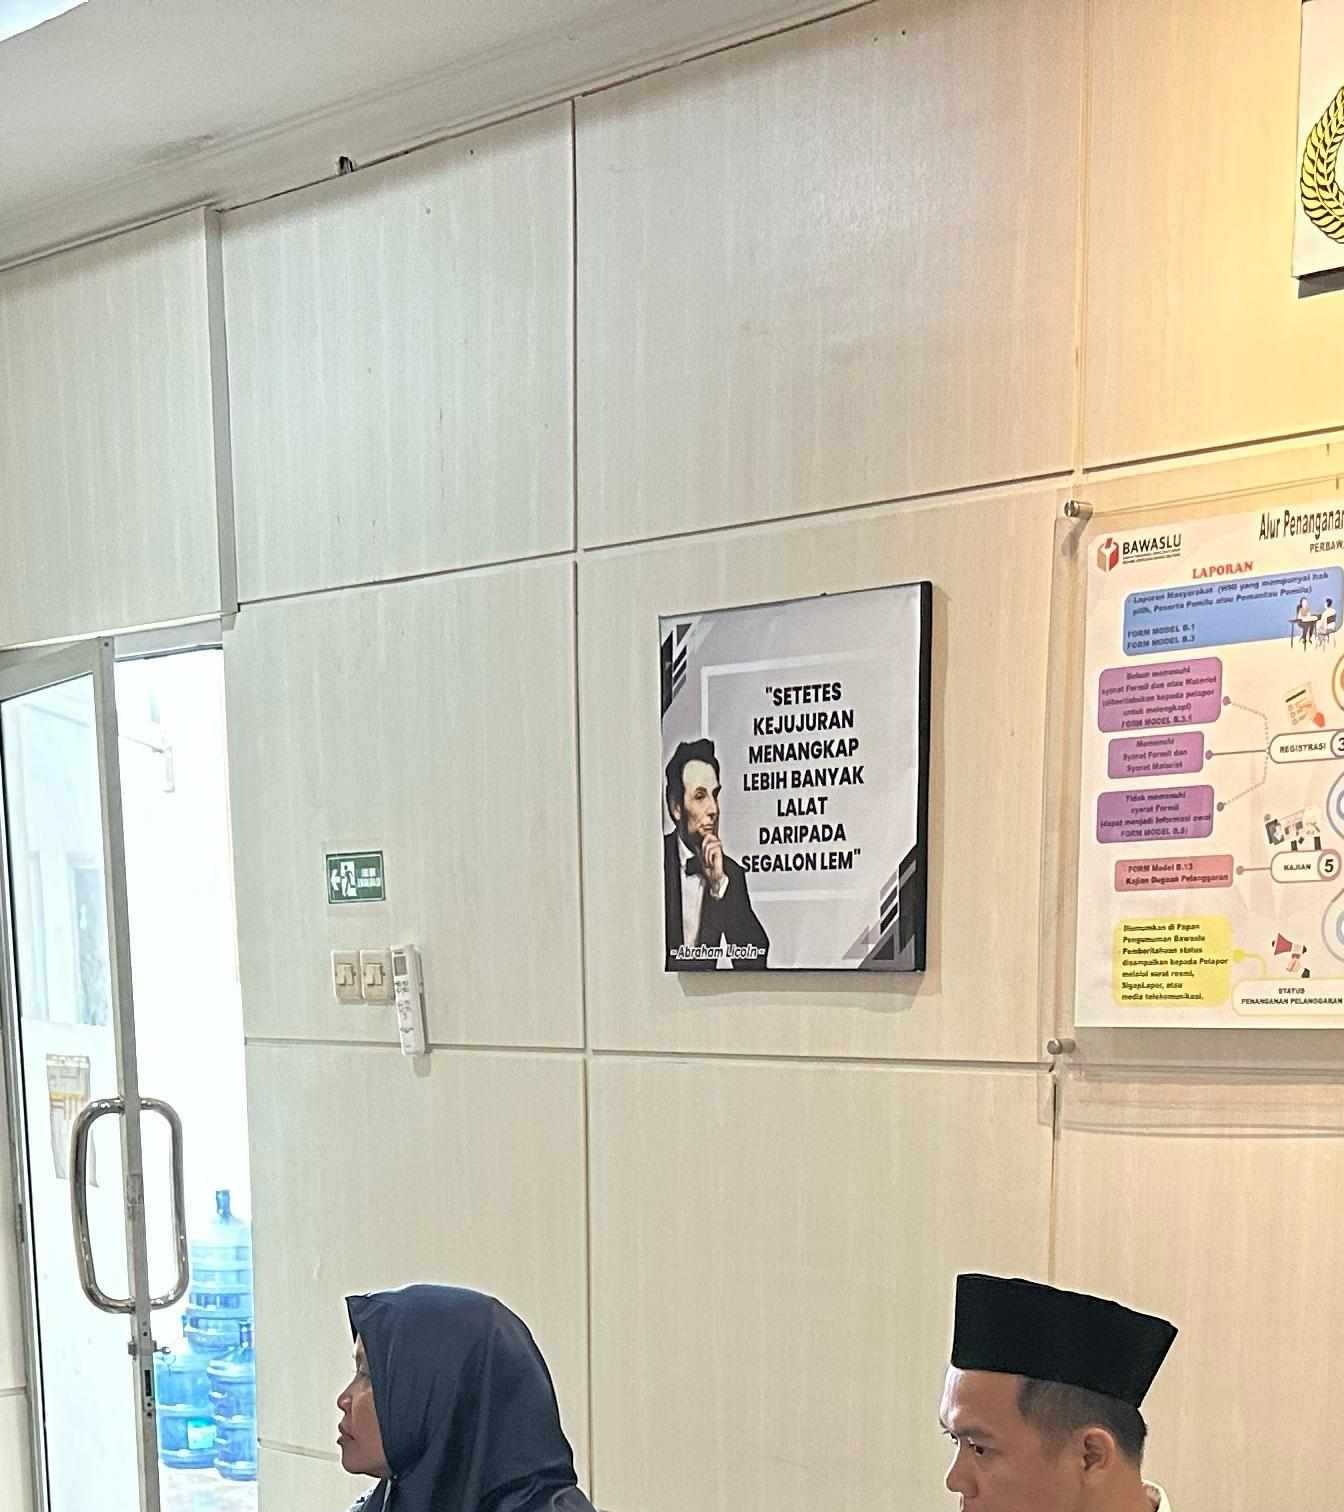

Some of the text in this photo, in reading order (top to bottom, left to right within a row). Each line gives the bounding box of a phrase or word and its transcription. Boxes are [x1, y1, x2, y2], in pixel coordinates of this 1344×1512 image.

[1259, 513, 1280, 541] Alur
[1122, 534, 1182, 555] BAWASLU
[1192, 561, 1254, 579] LAPORAN
[765, 683, 842, 707] "SETETES
[753, 710, 855, 735] KEJUJURAN
[749, 739, 859, 764] MENANGKAP
[1279, 743, 1326, 753] REGISTRASI
[743, 766, 864, 791] LEBIH BANYAK
[777, 797, 827, 816] LALAT
[759, 824, 846, 845] DARIPADA
[742, 849, 861, 873] SEGALON LEM"
[1324, 859, 1334, 872] 5
[1291, 997, 1343, 1005] PELANGGARAN
